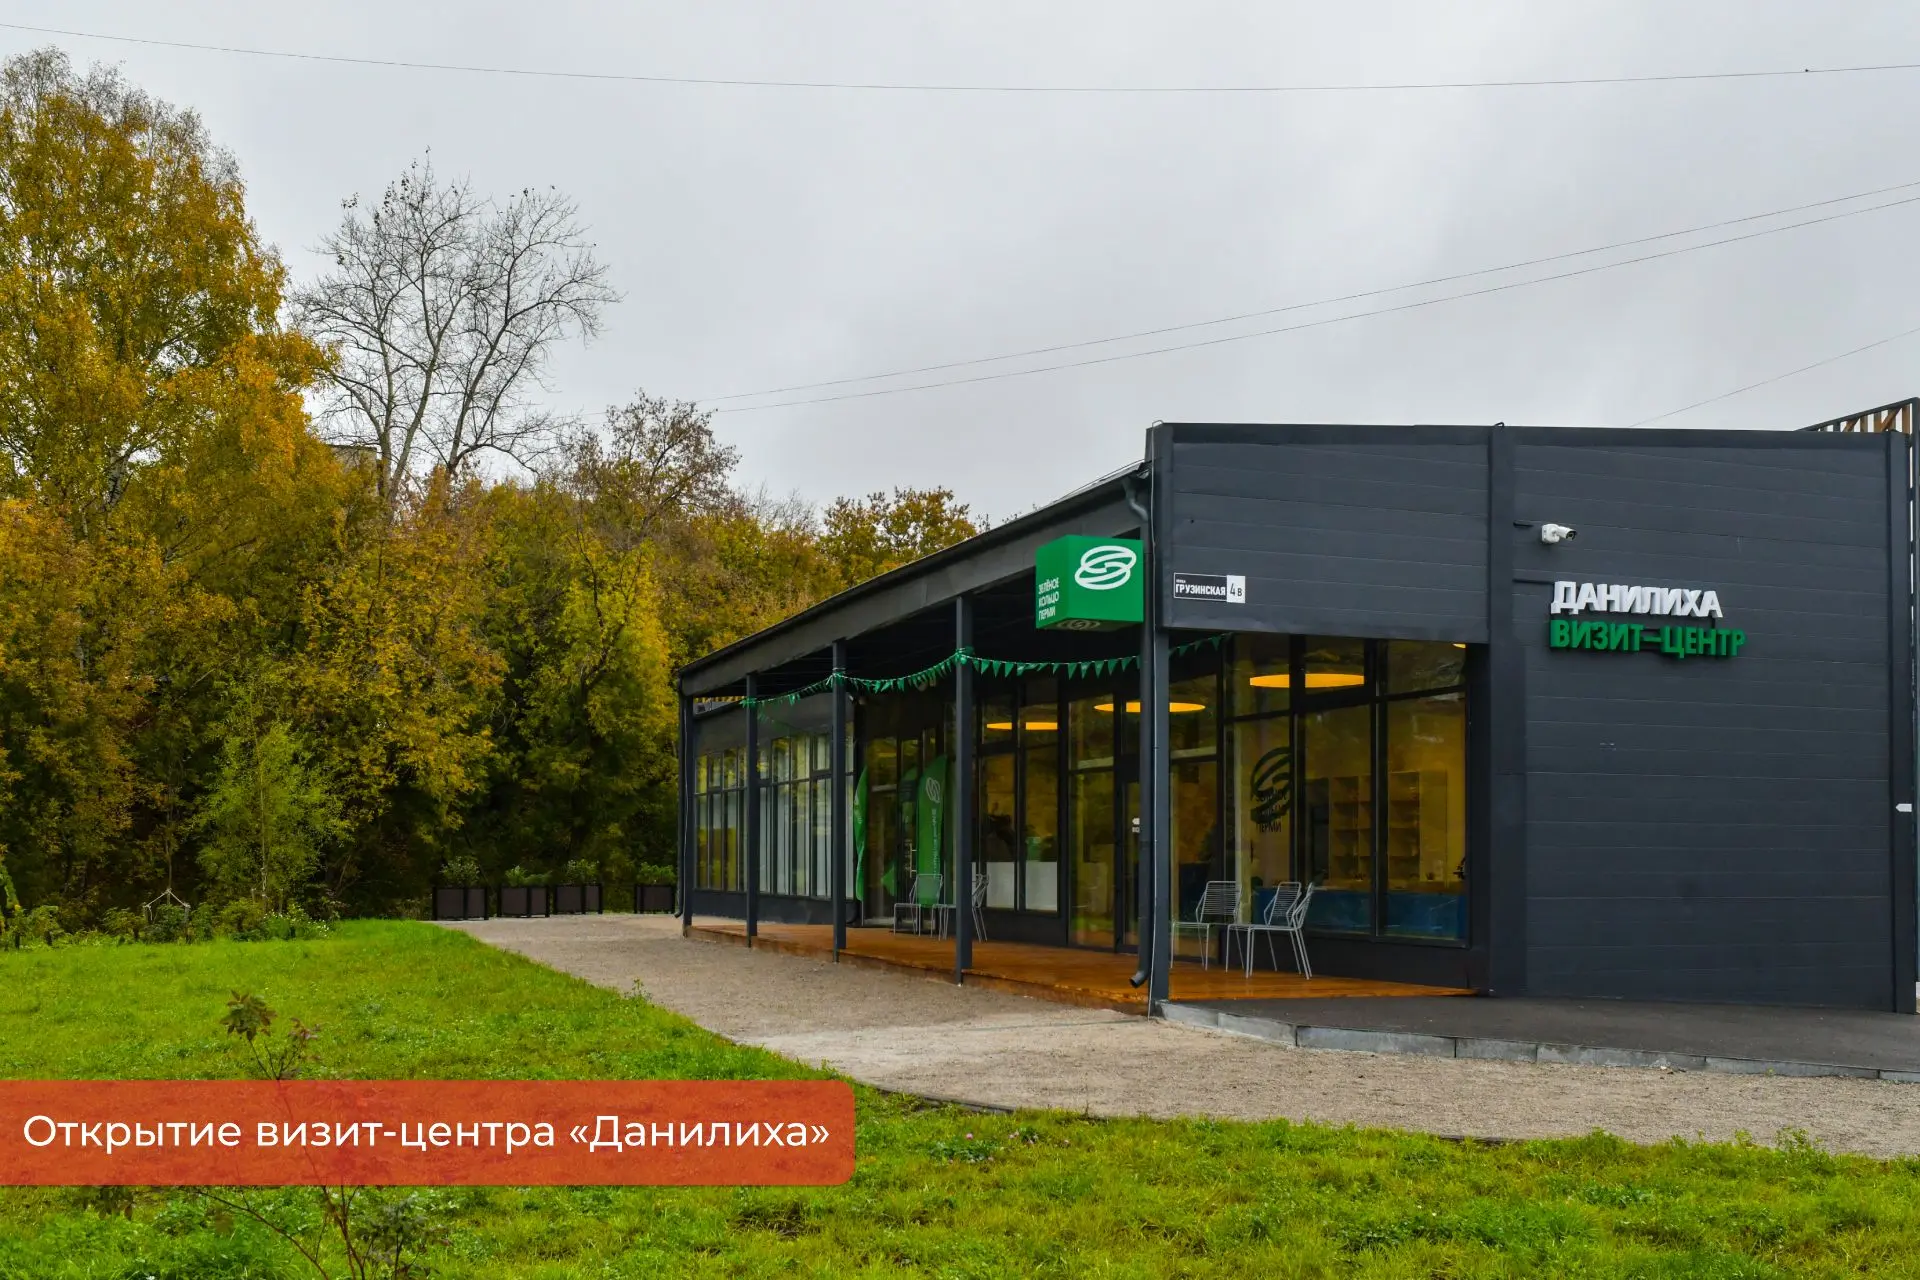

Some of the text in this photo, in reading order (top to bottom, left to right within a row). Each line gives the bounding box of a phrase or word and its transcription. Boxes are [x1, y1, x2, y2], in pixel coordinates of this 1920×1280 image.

[1175, 583, 1226, 596] ГРУЗИНСКАЯ
[1038, 591, 1060, 608] КОЛЬЦО
[1550, 580, 1724, 618] ДАНИЛИХА
[1038, 606, 1056, 621] ПЕРМИ
[1550, 619, 1747, 659] ВИЗИТ-ЦЕНТР
